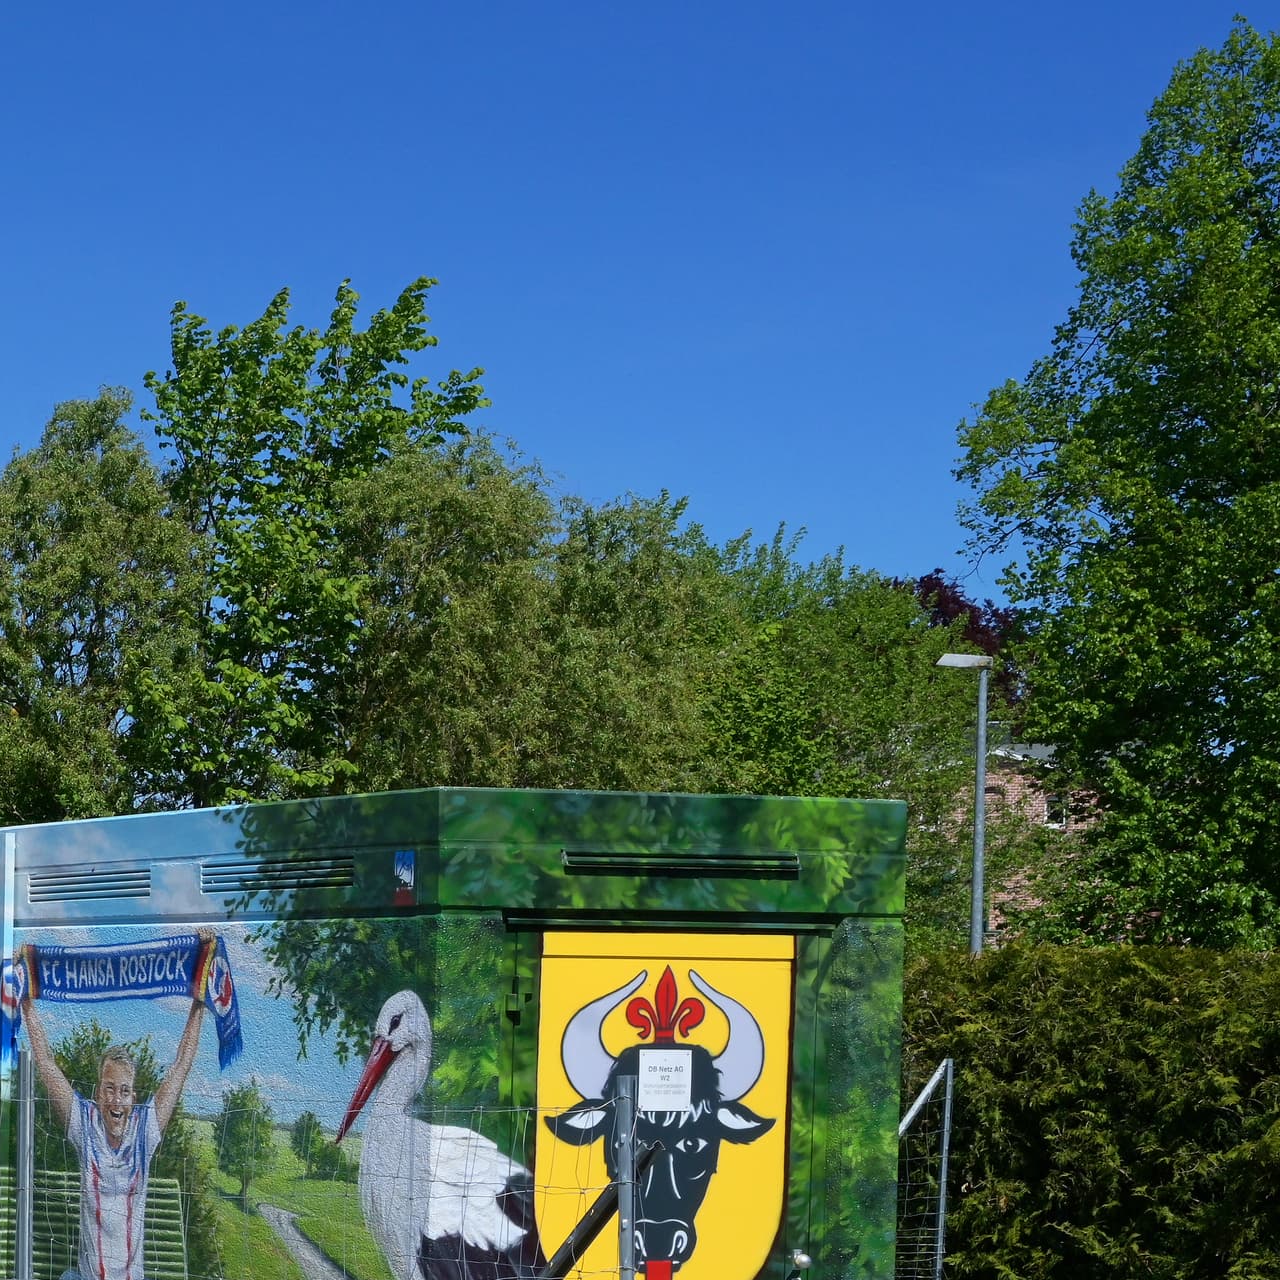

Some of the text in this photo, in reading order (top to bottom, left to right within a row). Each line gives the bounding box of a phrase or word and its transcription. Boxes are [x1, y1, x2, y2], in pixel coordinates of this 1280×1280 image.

[42, 950, 192, 989] FC HANSA ROSTOCK
[648, 1065, 684, 1073] DB Netz AG
